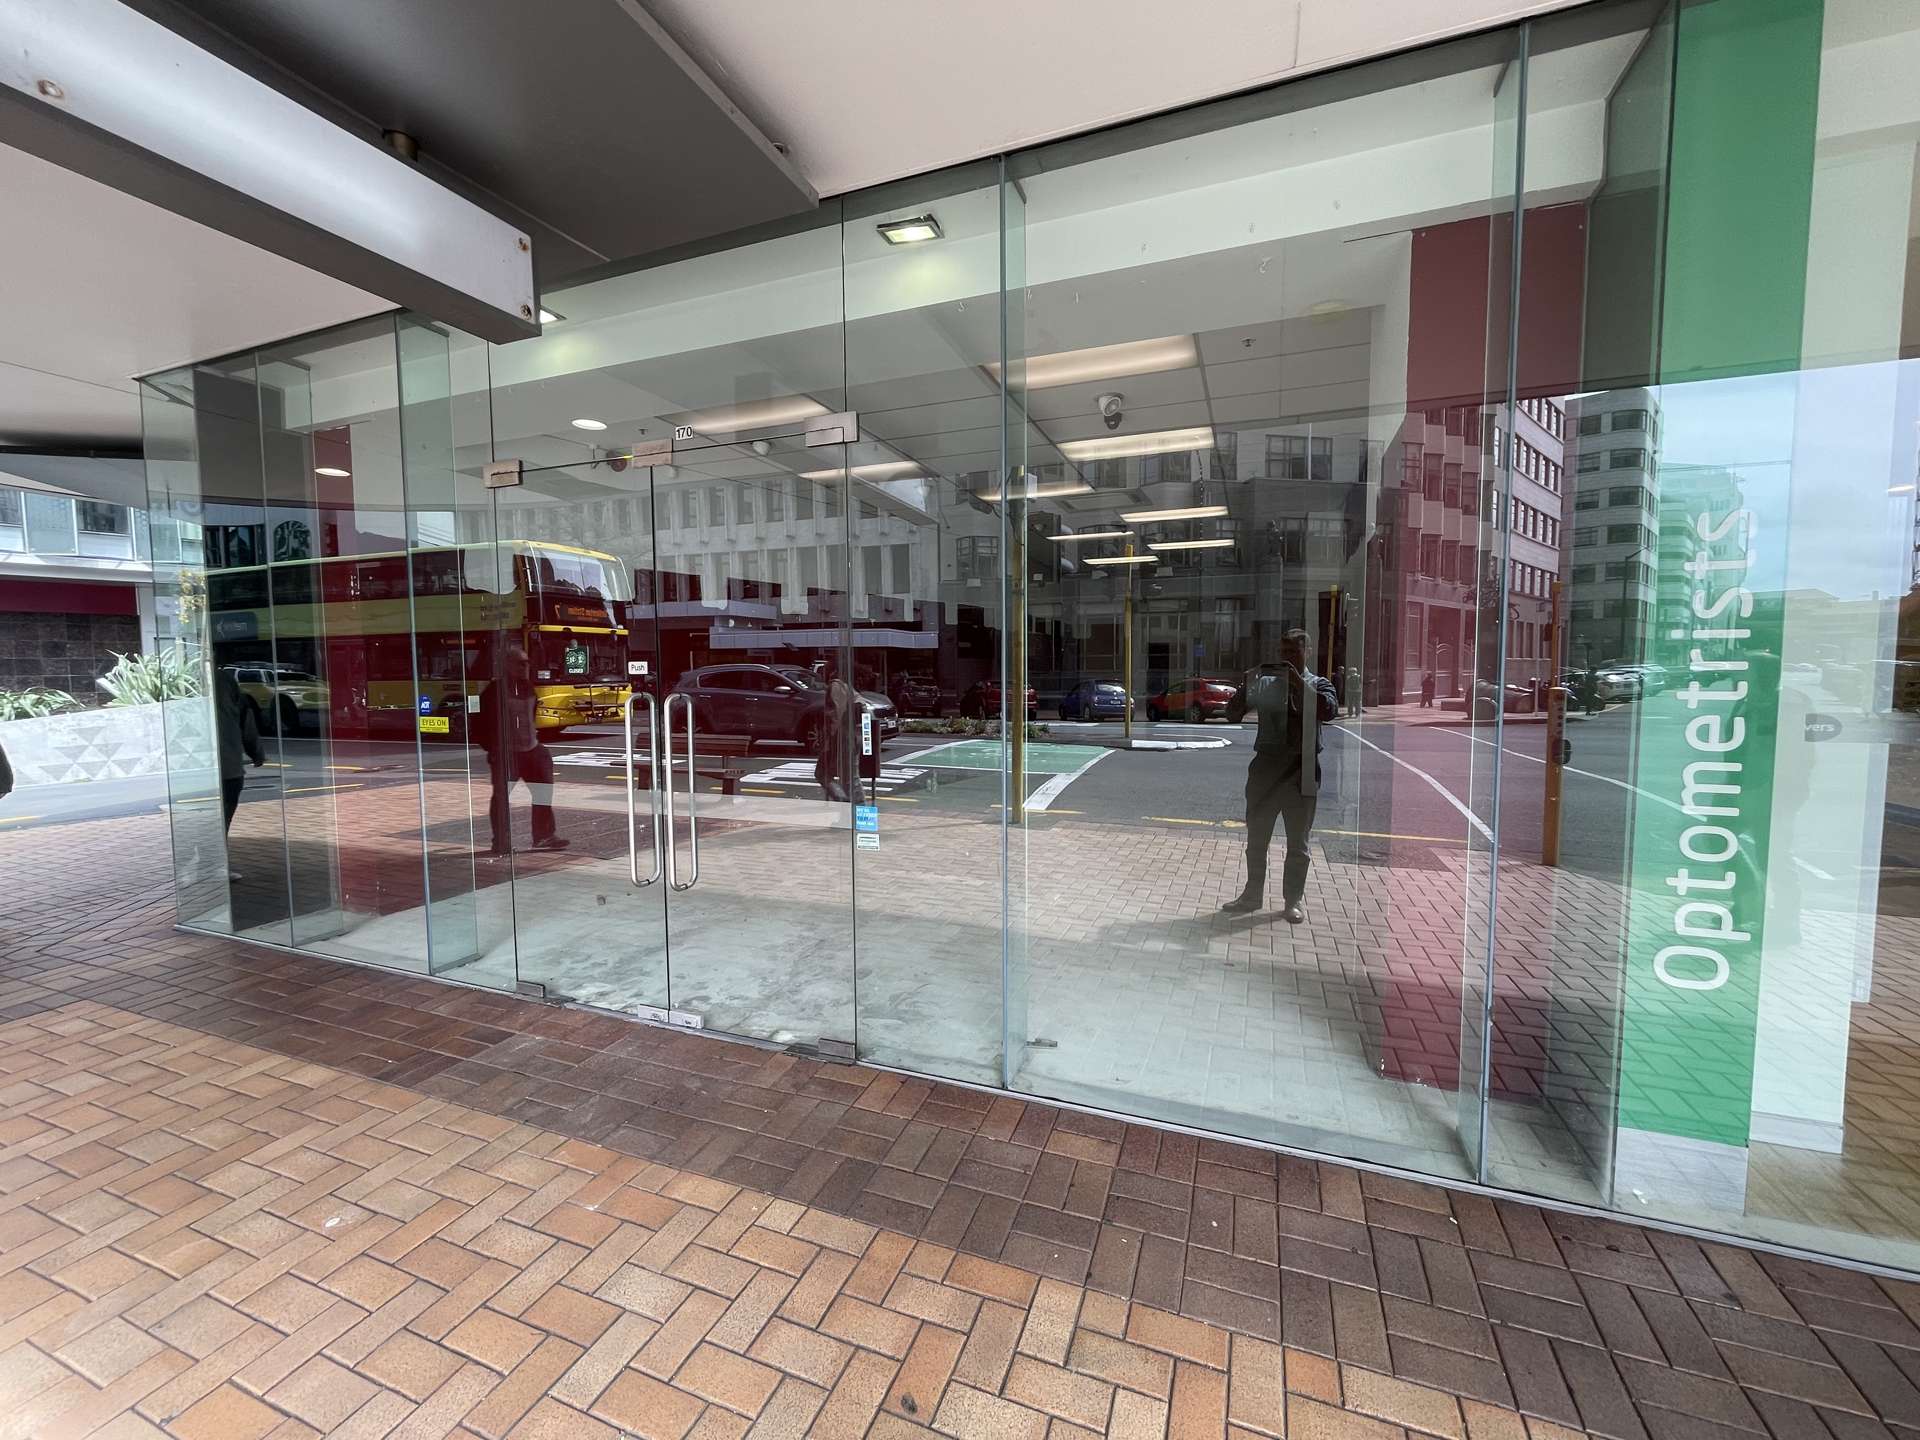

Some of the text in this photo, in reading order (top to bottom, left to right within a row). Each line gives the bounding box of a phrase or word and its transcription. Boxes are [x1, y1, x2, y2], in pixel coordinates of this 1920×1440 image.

[676, 426, 693, 439] 170
[631, 663, 645, 671] Push
[1652, 507, 1758, 991] Optometrists
